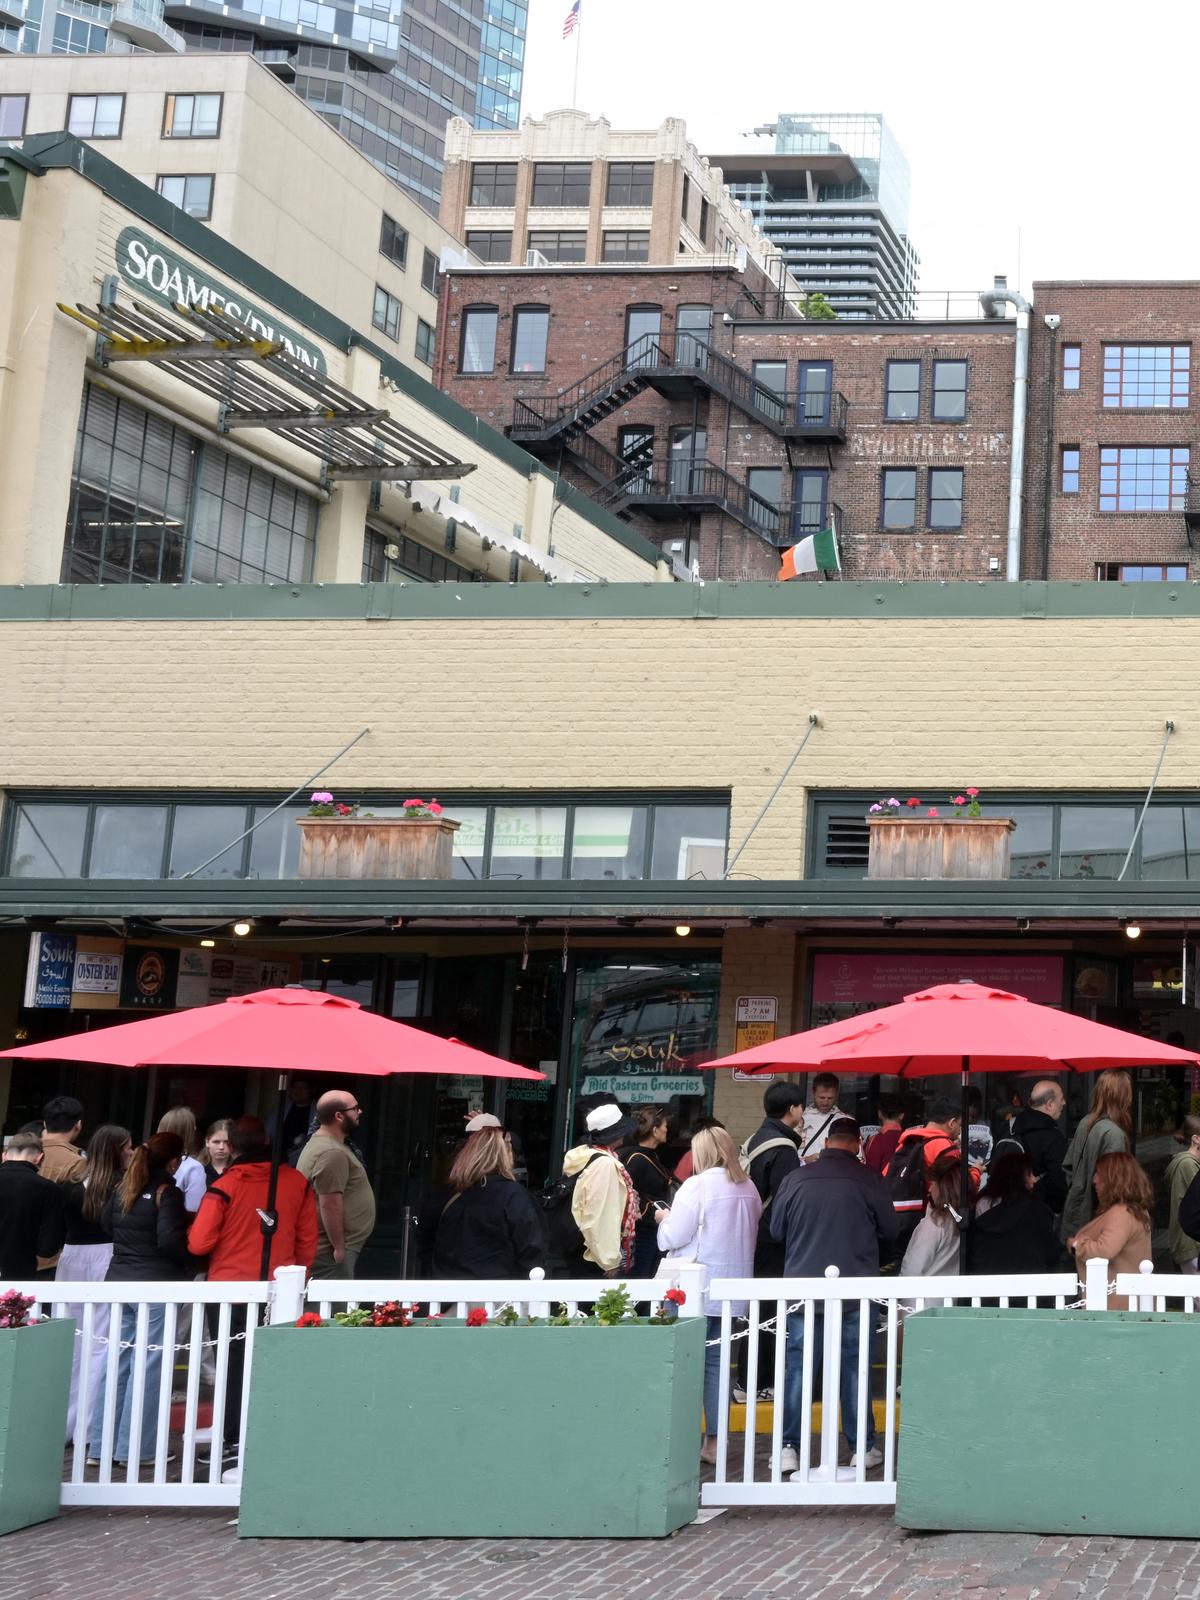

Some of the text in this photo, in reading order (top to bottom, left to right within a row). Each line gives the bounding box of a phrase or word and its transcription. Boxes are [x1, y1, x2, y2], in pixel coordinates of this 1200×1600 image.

[41, 940, 73, 963] Souk
[77, 963, 119, 981] OYSTER BAR
[36, 993, 53, 1005] FOODS
[57, 995, 71, 1005] GIFTS
[603, 1032, 688, 1062] Souk
[588, 1076, 700, 1092] Mid Eastern Groceries
